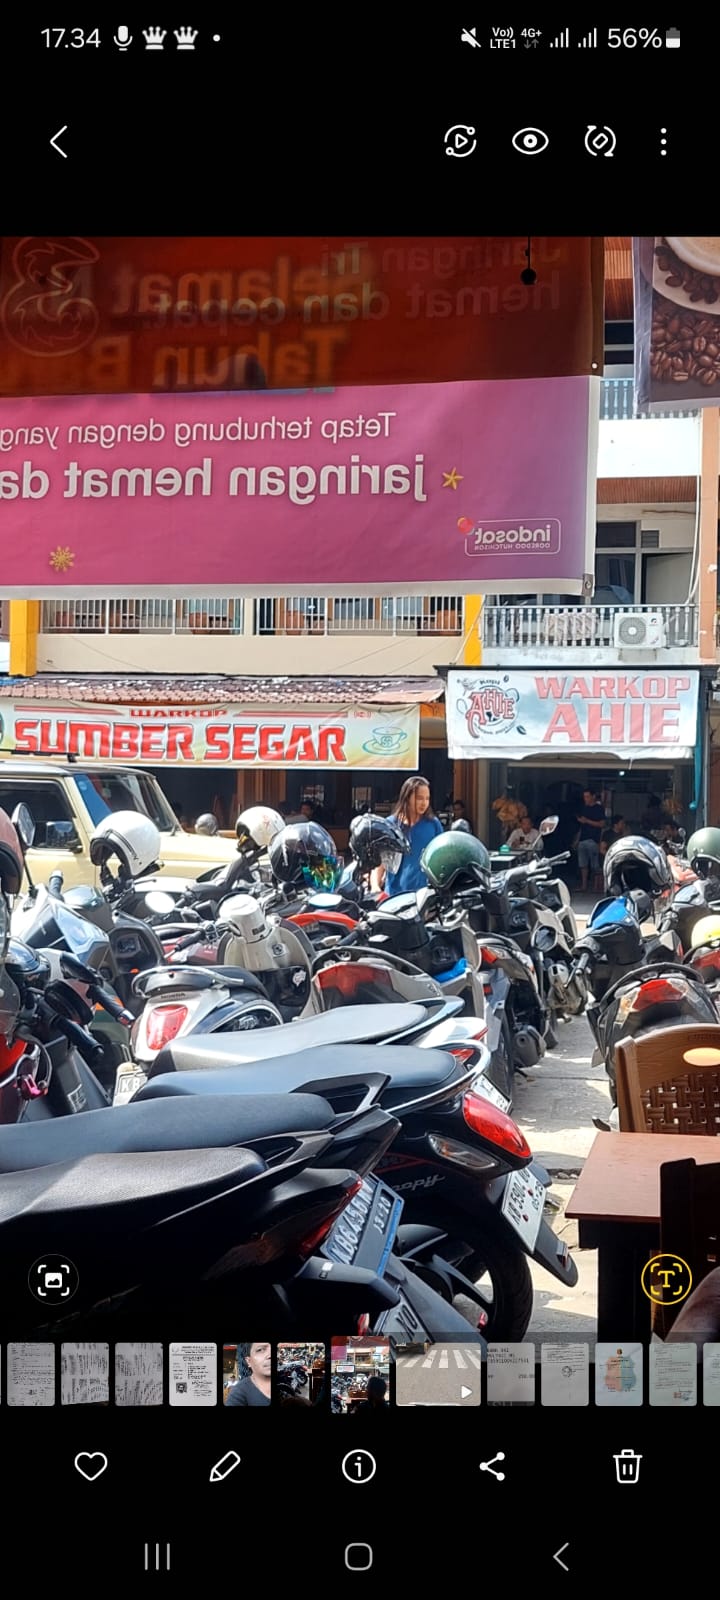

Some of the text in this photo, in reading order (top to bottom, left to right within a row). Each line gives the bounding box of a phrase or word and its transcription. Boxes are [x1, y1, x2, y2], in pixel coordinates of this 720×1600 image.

[533, 676, 691, 699] WARKOP
[129, 708, 229, 718] WARKOP
[465, 688, 516, 739] AHIE
[541, 702, 682, 743] AHIE
[15, 718, 347, 762] SUMBER SEGAR
